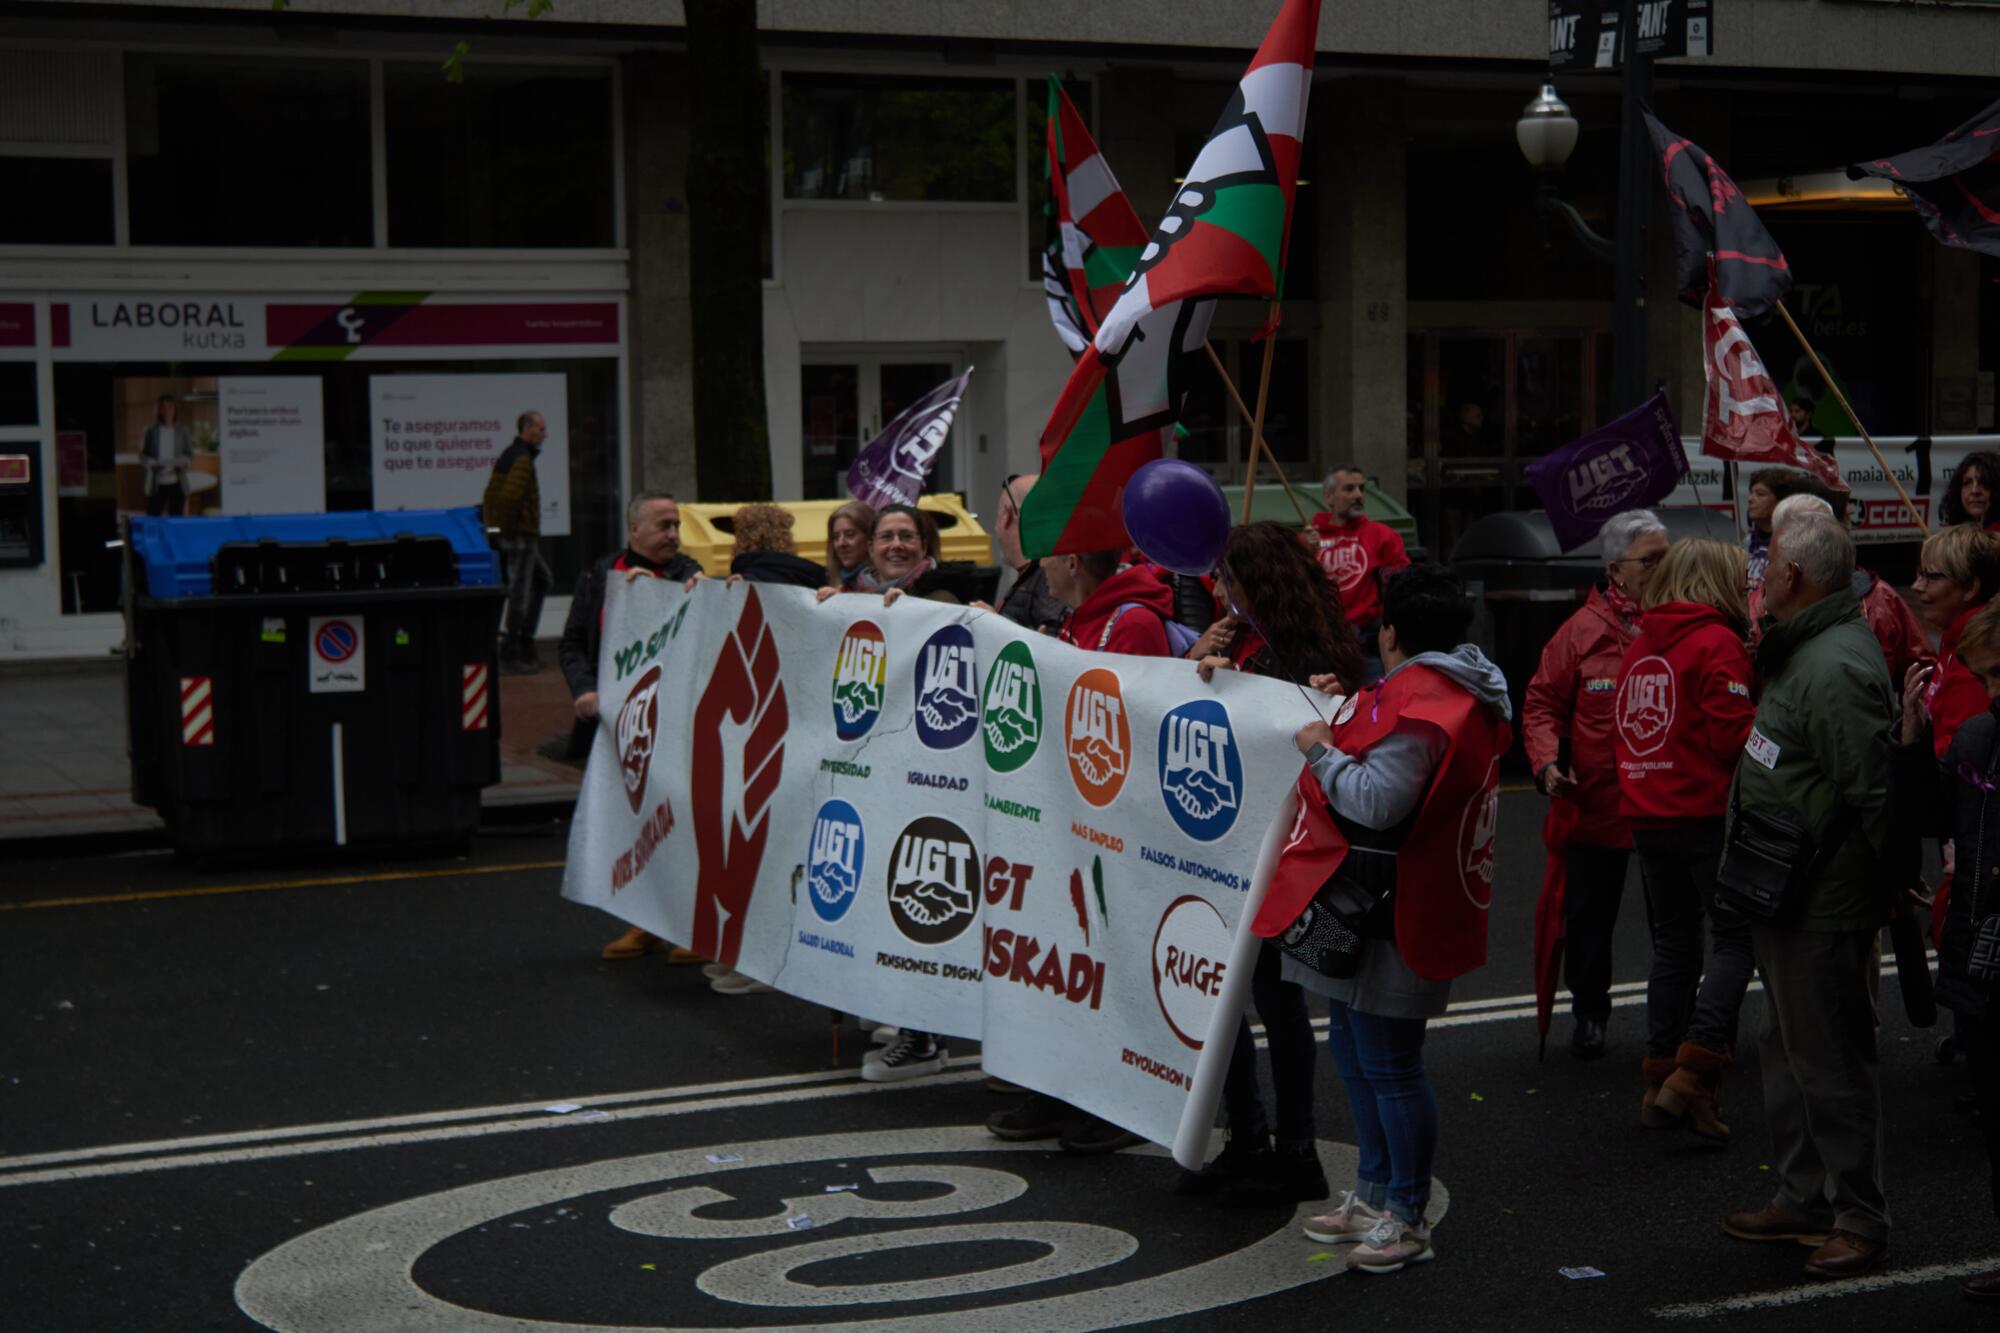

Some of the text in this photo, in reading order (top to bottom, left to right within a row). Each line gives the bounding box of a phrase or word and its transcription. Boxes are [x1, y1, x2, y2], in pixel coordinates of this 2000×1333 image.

[92, 303, 244, 327] LABORAL
[184, 331, 246, 349] kutxa
[382, 418, 501, 435] Te aseguramos
[385, 437, 492, 453] lo que quieres
[384, 458, 413, 471] que
[416, 456, 433, 468] te
[1568, 443, 1635, 500] UGT
[1848, 466, 1914, 481] maiaak
[840, 637, 886, 688] UGT
[926, 644, 977, 697] UGT
[994, 660, 1036, 717] UGT
[1586, 678, 1611, 690] UGT
[1627, 673, 1669, 712] UGT
[1728, 681, 1750, 698] UG
[1072, 685, 1121, 748] UGT
[1168, 714, 1230, 781] UGT
[907, 771, 969, 791] IGUALDAD
[988, 796, 1041, 822] AMBIENTE
[814, 817, 860, 866] UGT
[1089, 831, 1124, 853] EMPLEO
[895, 834, 971, 891] UGT
[1140, 846, 1177, 869] FALSOS
[1178, 856, 1240, 889] AUTONOMOS
[983, 854, 1034, 911] GT
[821, 937, 854, 958] LABORAL
[876, 952, 938, 975] PENSIONES
[1165, 945, 1226, 996] RUGE
[1121, 1048, 1184, 1087] REVOLUCION
